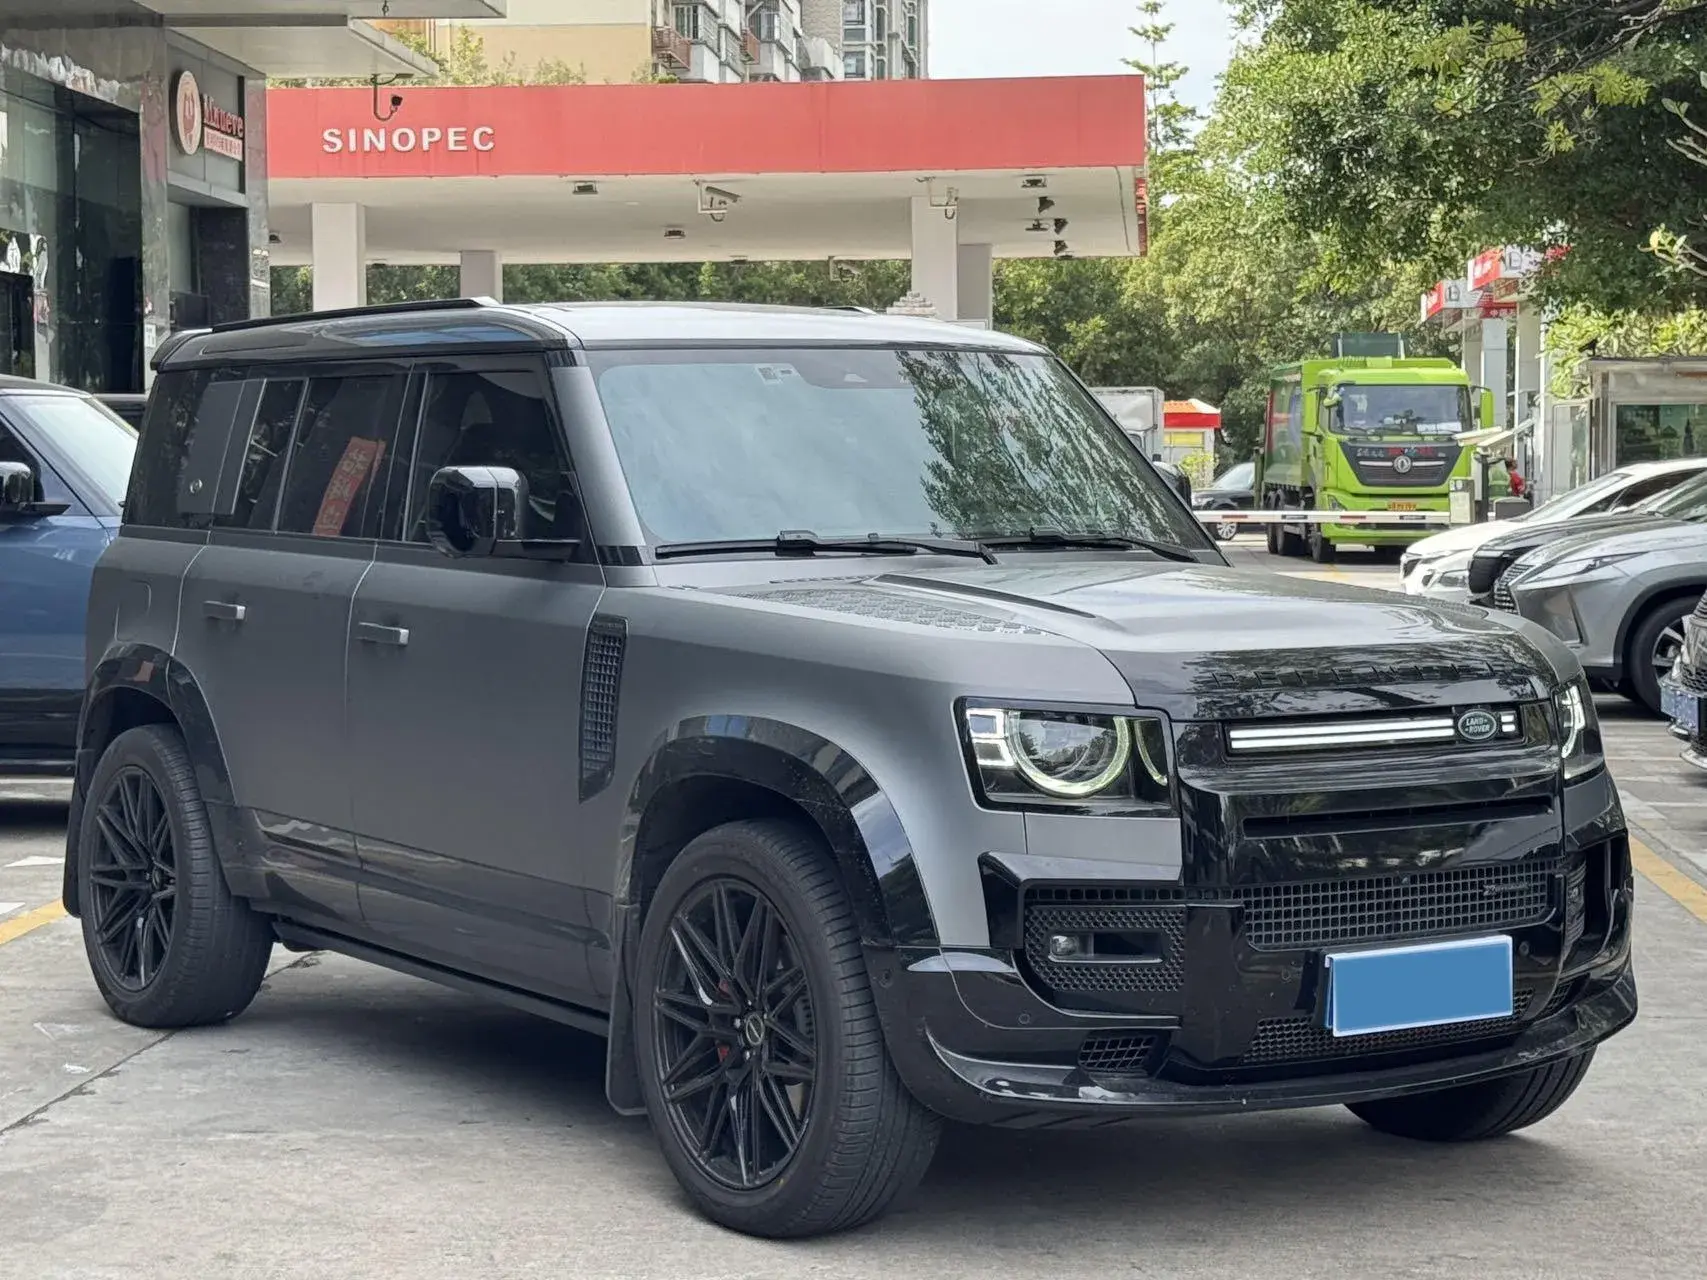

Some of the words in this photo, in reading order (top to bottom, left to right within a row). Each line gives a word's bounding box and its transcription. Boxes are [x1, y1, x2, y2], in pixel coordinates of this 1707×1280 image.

[322, 126, 496, 153] SINOPEC
[1466, 717, 1484, 726] LAND
[1468, 724, 1490, 733] ROVER
